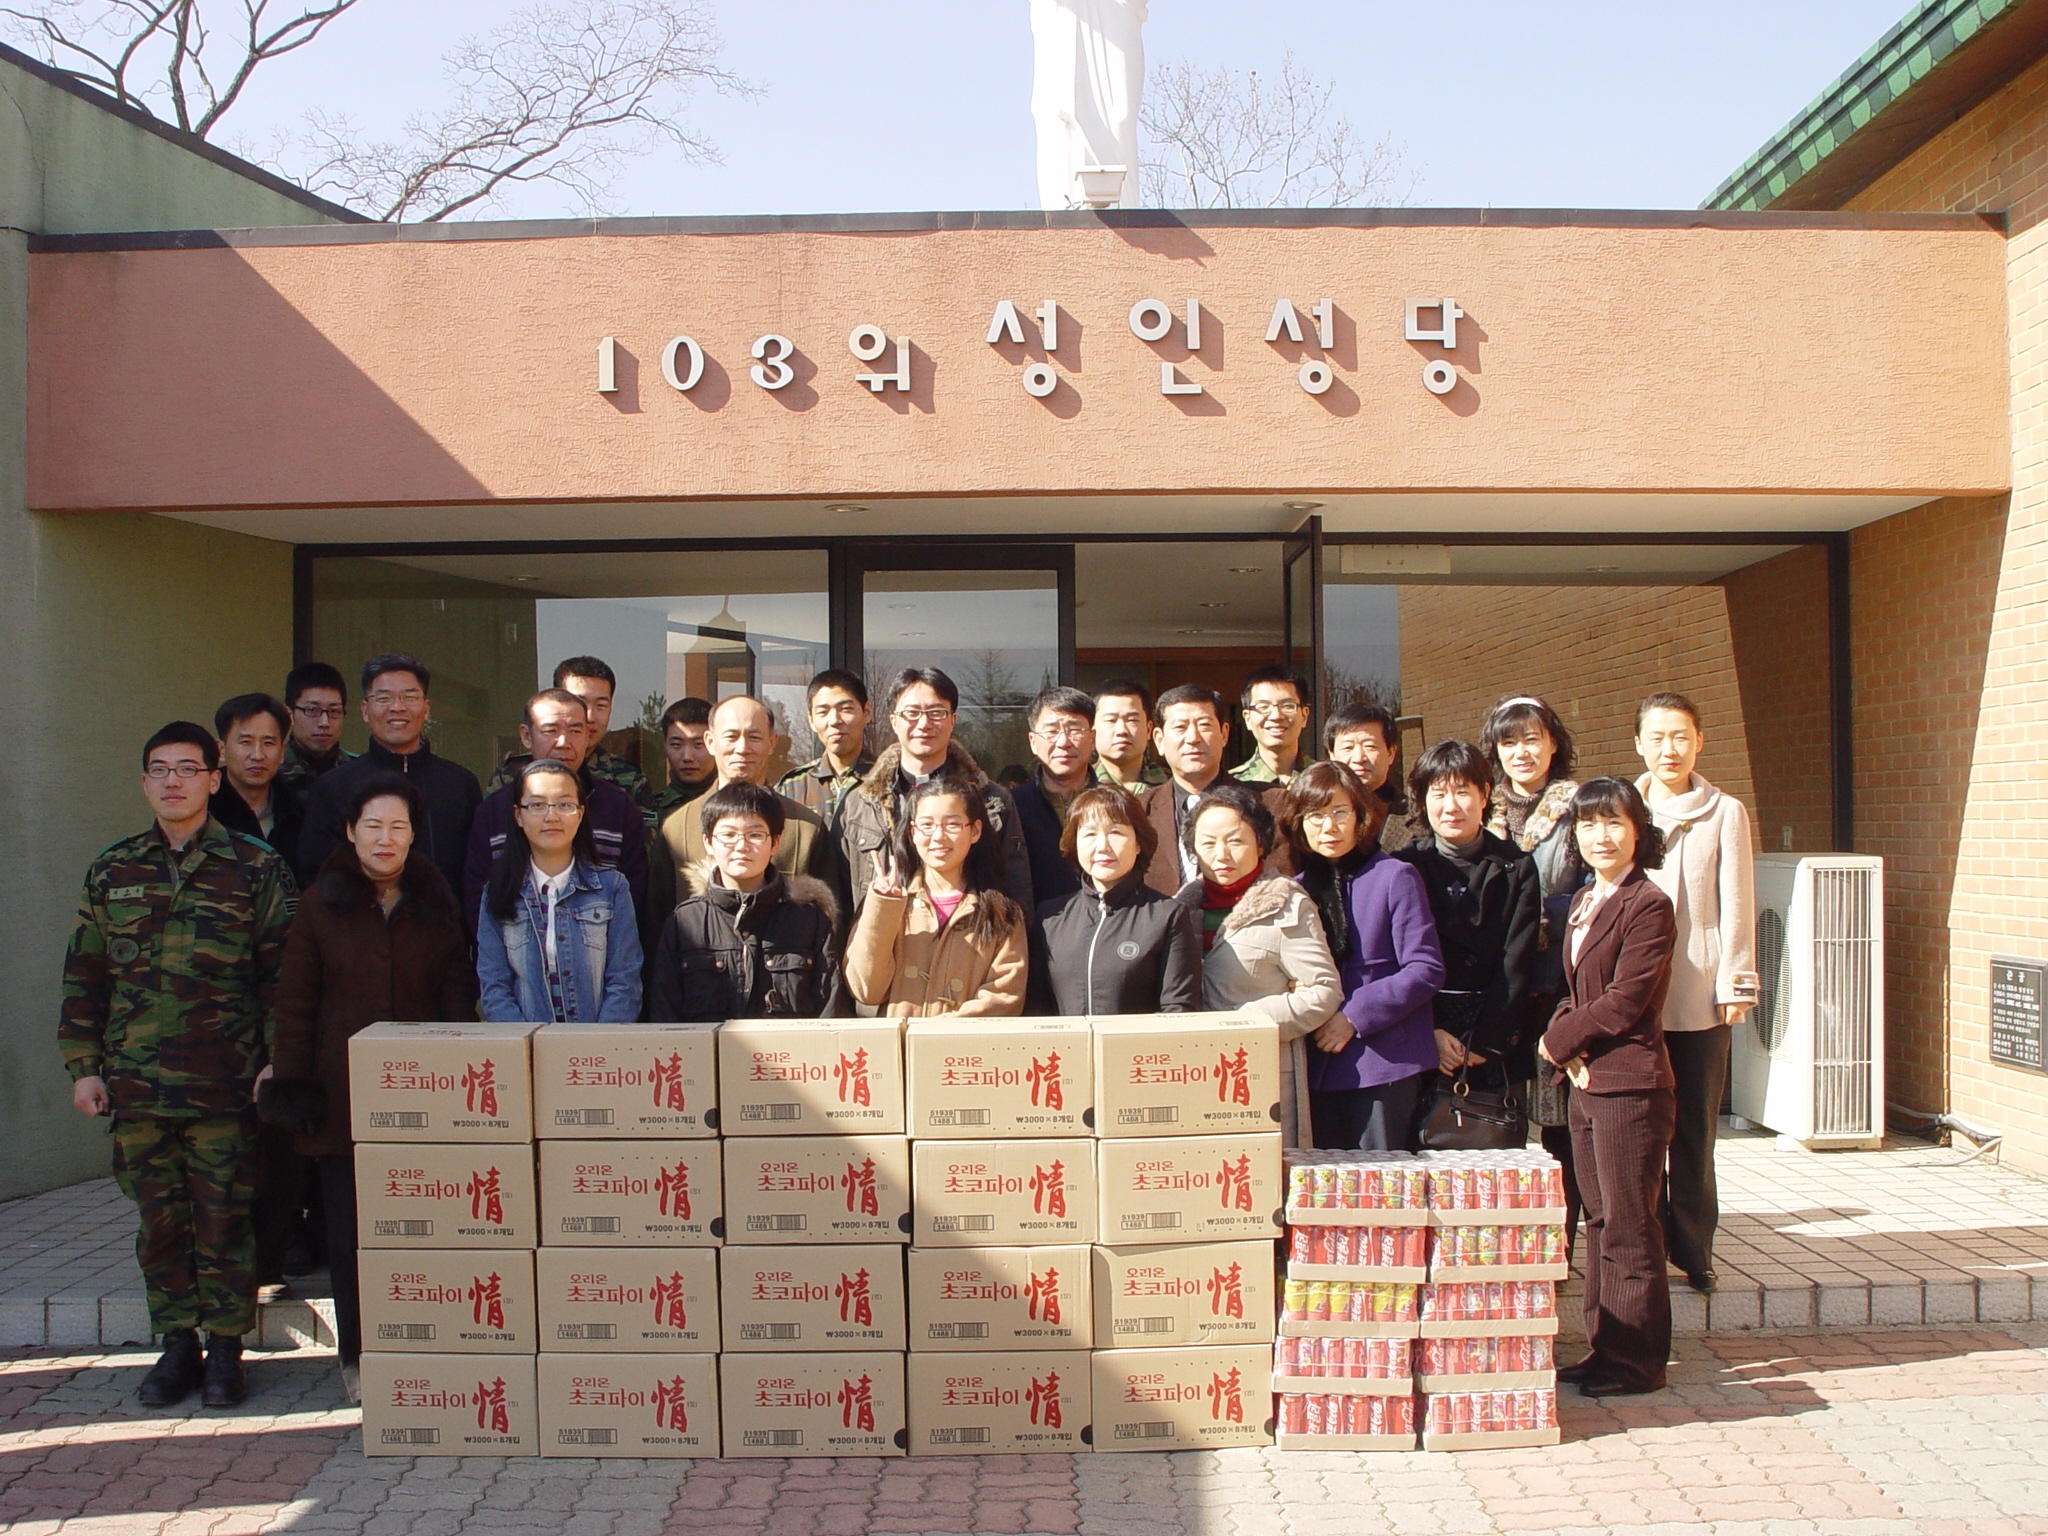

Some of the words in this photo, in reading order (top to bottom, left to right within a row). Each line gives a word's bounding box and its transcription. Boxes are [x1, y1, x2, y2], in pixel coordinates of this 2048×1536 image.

[382, 1061, 421, 1072] 오리온
[568, 1056, 607, 1068] 오리온
[752, 1052, 792, 1063] 오리온
[944, 1056, 984, 1068] 오리온
[1132, 1054, 1172, 1066] 오리온
[380, 1072, 455, 1093] 초코파이
[461, 1058, 498, 1117] 情
[565, 1067, 642, 1089] 초코파이
[648, 1052, 685, 1112] 情
[750, 1062, 827, 1084] 초코파이
[833, 1047, 871, 1107] 情
[941, 1067, 1019, 1088] 초코파이
[1025, 1051, 1063, 1112] 情
[1129, 1064, 1207, 1085] 초코파이
[1213, 1046, 1250, 1107] 情
[387, 1169, 426, 1180] 오리온
[575, 1164, 614, 1176] 오리온
[760, 1162, 800, 1174] 오리온
[947, 1164, 987, 1176] 오리온
[1132, 1170, 1210, 1192] 초코파이
[1216, 1153, 1253, 1213] 情
[1135, 1160, 1174, 1172] 오리온
[385, 1180, 460, 1201] 초코파이
[466, 1165, 503, 1225] 情
[572, 1175, 648, 1197] 초코파이
[654, 1161, 691, 1221] 情
[757, 1172, 835, 1194] 초코파이
[841, 1156, 878, 1217] 情
[945, 1174, 1023, 1195] 초코파이
[1029, 1159, 1066, 1218] 情
[390, 1273, 428, 1285] 오리온
[570, 1274, 608, 1285] 오리온
[754, 1271, 794, 1283] 오리온
[943, 1271, 983, 1282] 오리온
[1126, 1267, 1166, 1278] 오리온
[388, 1284, 462, 1305] 초코파이
[468, 1271, 504, 1330] 情
[567, 1285, 644, 1305] 초코파이
[649, 1271, 686, 1329] 情
[752, 1282, 829, 1303] 초코파이
[835, 1267, 872, 1327] 情
[940, 1281, 1018, 1302] 초코파이
[1024, 1266, 1061, 1326] 情
[1124, 1277, 1201, 1298] 초코파이
[1207, 1261, 1244, 1319] 情
[393, 1379, 432, 1390] 오리온
[571, 1377, 610, 1388] 오리온
[757, 1378, 796, 1390] 오리온
[944, 1377, 984, 1388] 오리온
[1124, 1383, 1201, 1403] 초코파이
[1207, 1367, 1244, 1423] 情
[1127, 1374, 1166, 1385] 오리온
[391, 1390, 466, 1410] 초코파이
[472, 1376, 509, 1434] 情
[569, 1388, 645, 1409] 초코파이
[651, 1374, 688, 1434] 情
[754, 1388, 831, 1410] 초코파이
[837, 1373, 874, 1433] 情
[942, 1387, 1019, 1408] 초코파이
[1025, 1371, 1062, 1430] 情
